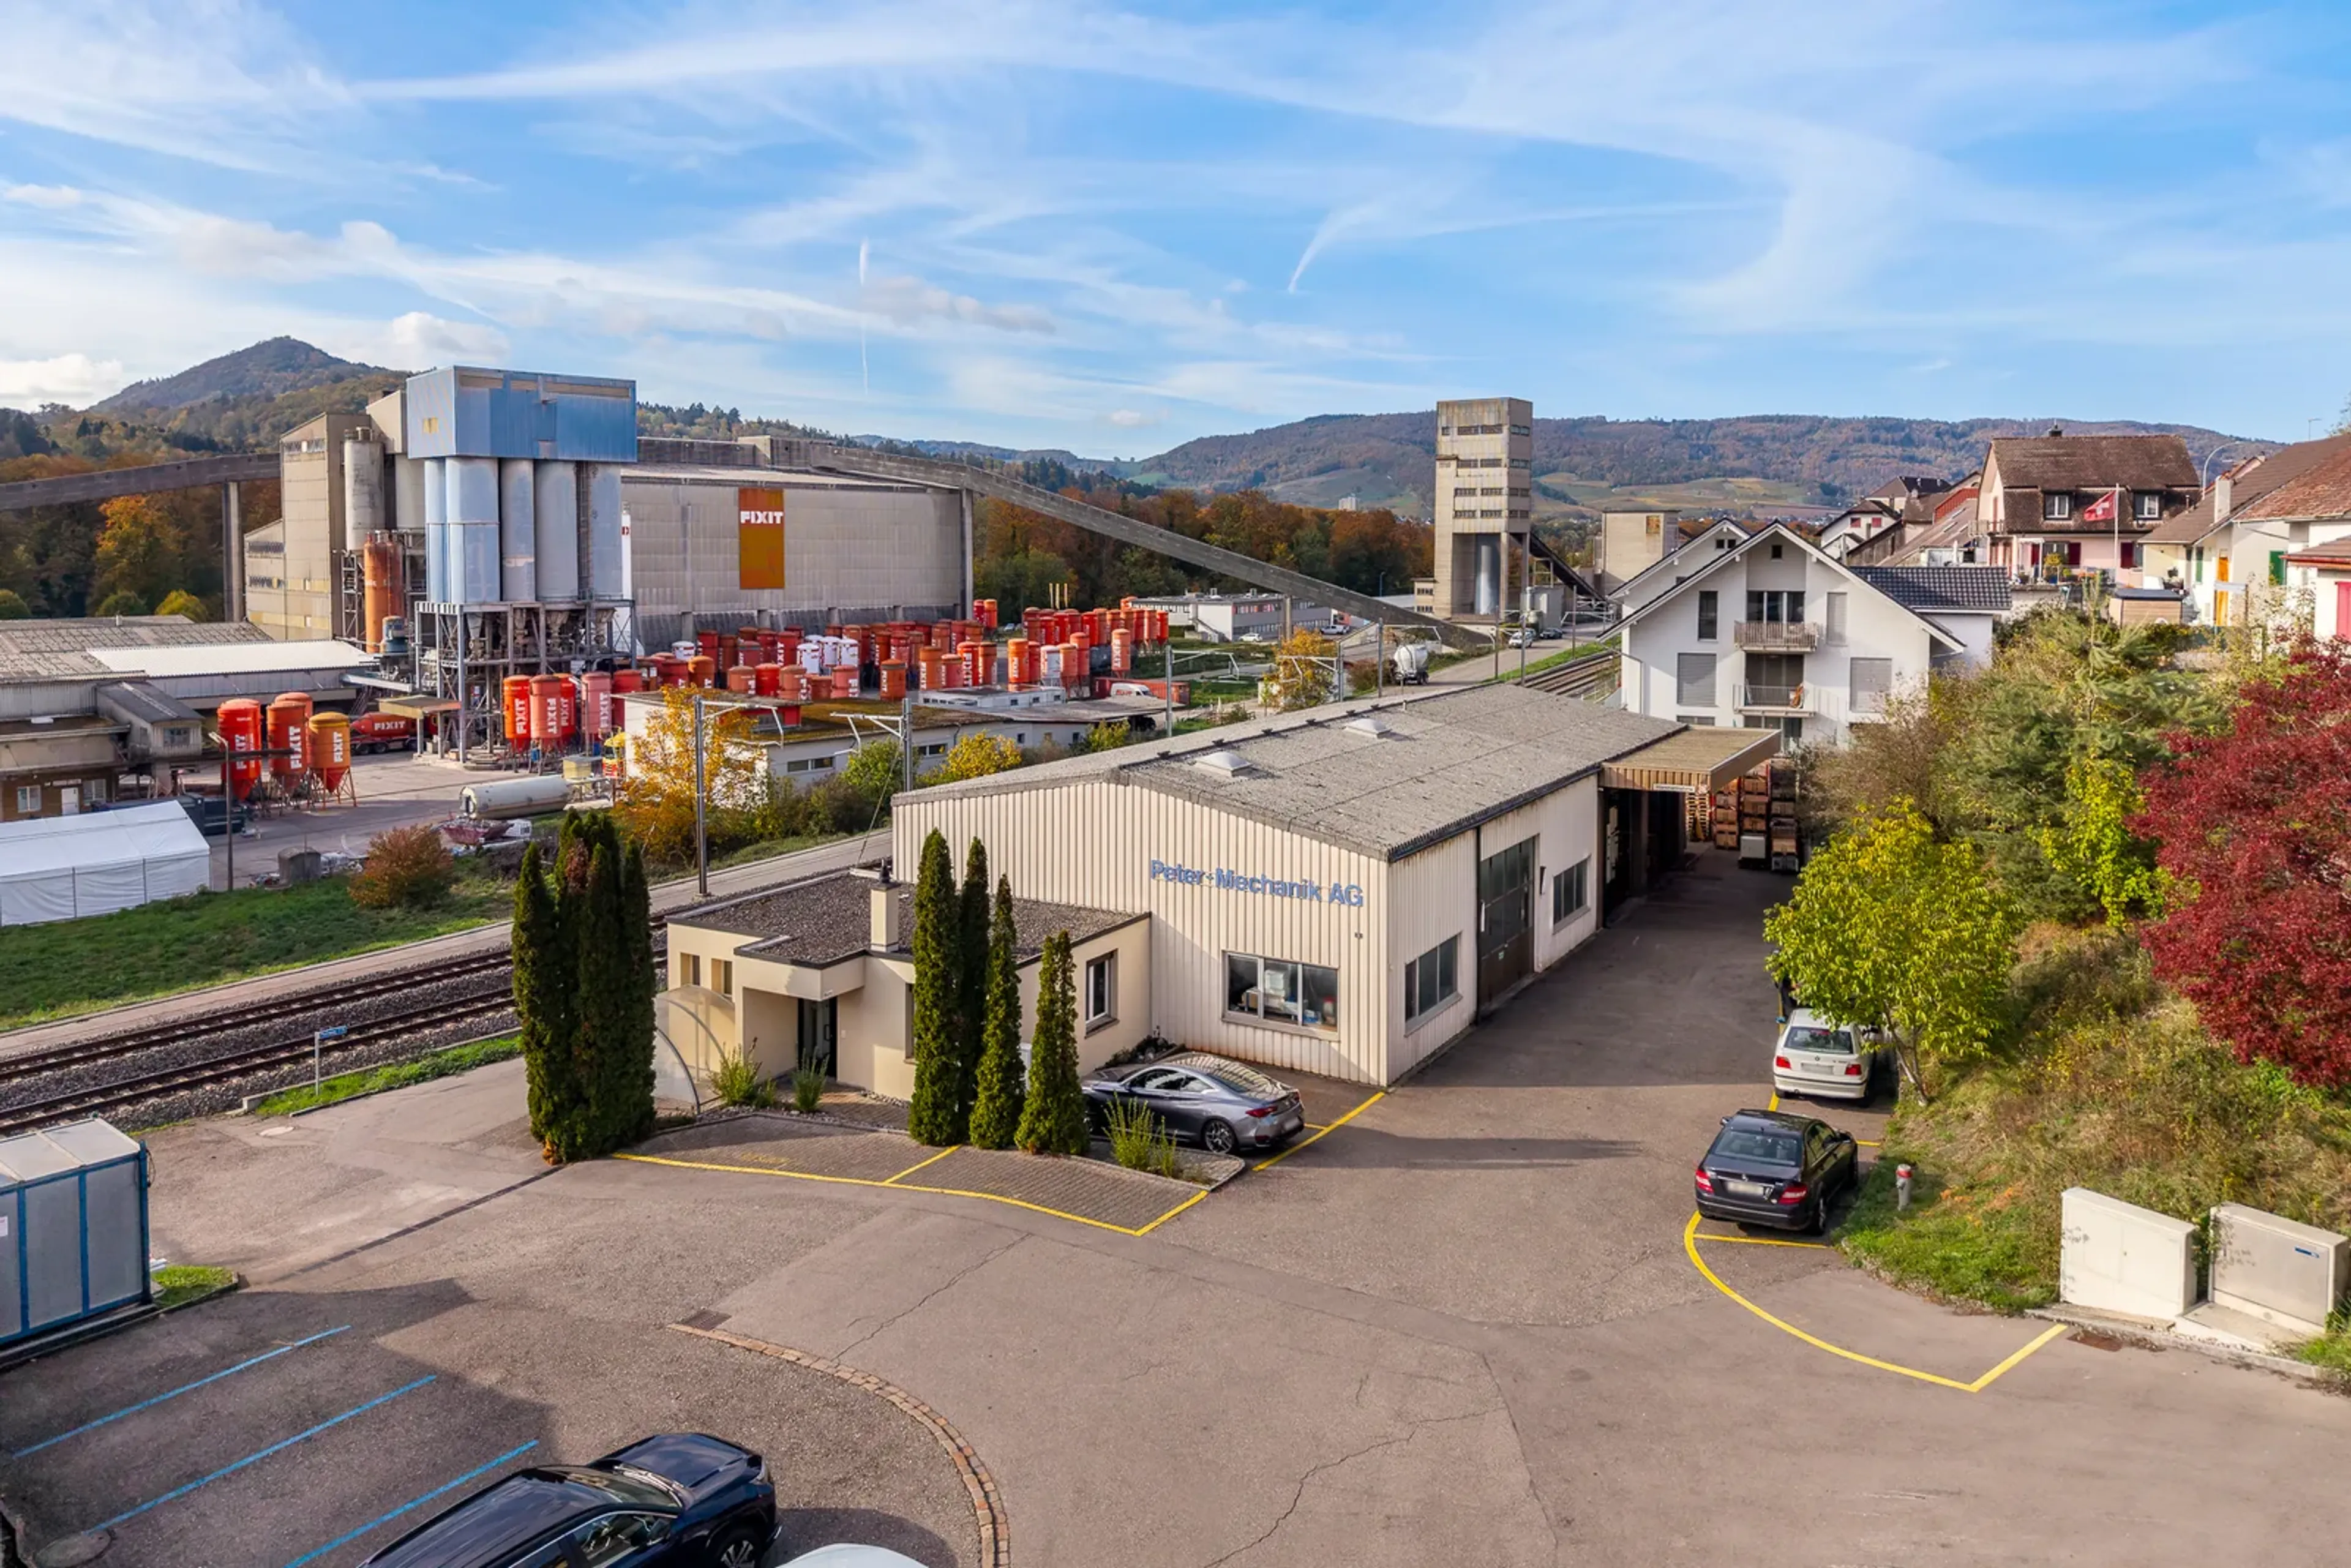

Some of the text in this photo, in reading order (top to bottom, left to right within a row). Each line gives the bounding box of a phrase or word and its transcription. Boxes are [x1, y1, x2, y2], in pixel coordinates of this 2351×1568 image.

[740, 511, 784, 524] FIXIT
[963, 653, 972, 686] FIXIT
[374, 721, 405, 730] FIXIT
[515, 698, 527, 734] FIXIT
[547, 697, 558, 734] FIXIT
[560, 697, 569, 727] FIXIT
[599, 692, 609, 729] FIXIT
[289, 726, 302, 770] FIXIT
[333, 732, 343, 762] FIXIT
[1328, 882, 1362, 907] AG
